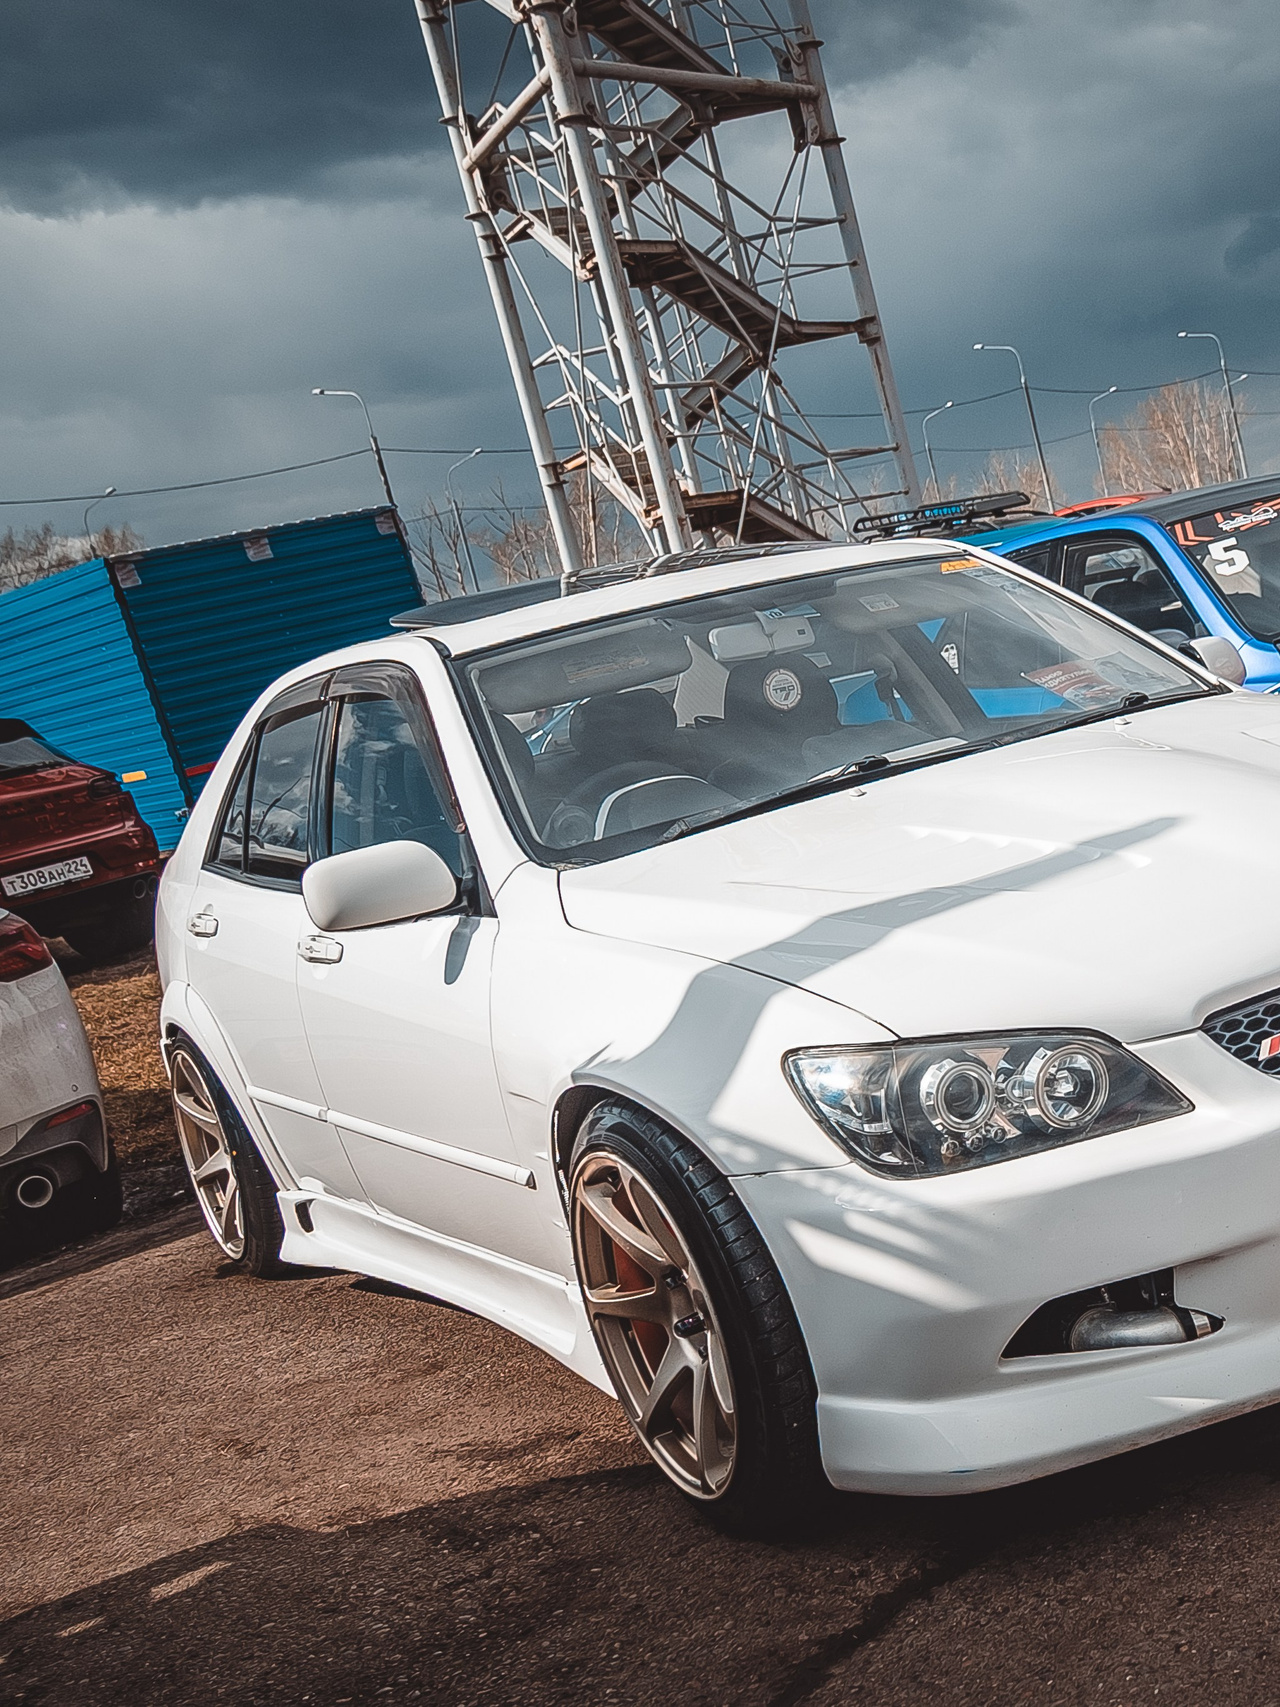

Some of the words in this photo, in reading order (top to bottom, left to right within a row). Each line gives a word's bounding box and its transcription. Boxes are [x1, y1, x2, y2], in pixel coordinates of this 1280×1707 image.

[1206, 536, 1250, 577] 5
[7, 868, 67, 893] Т308АН
[64, 858, 89, 876] 224
